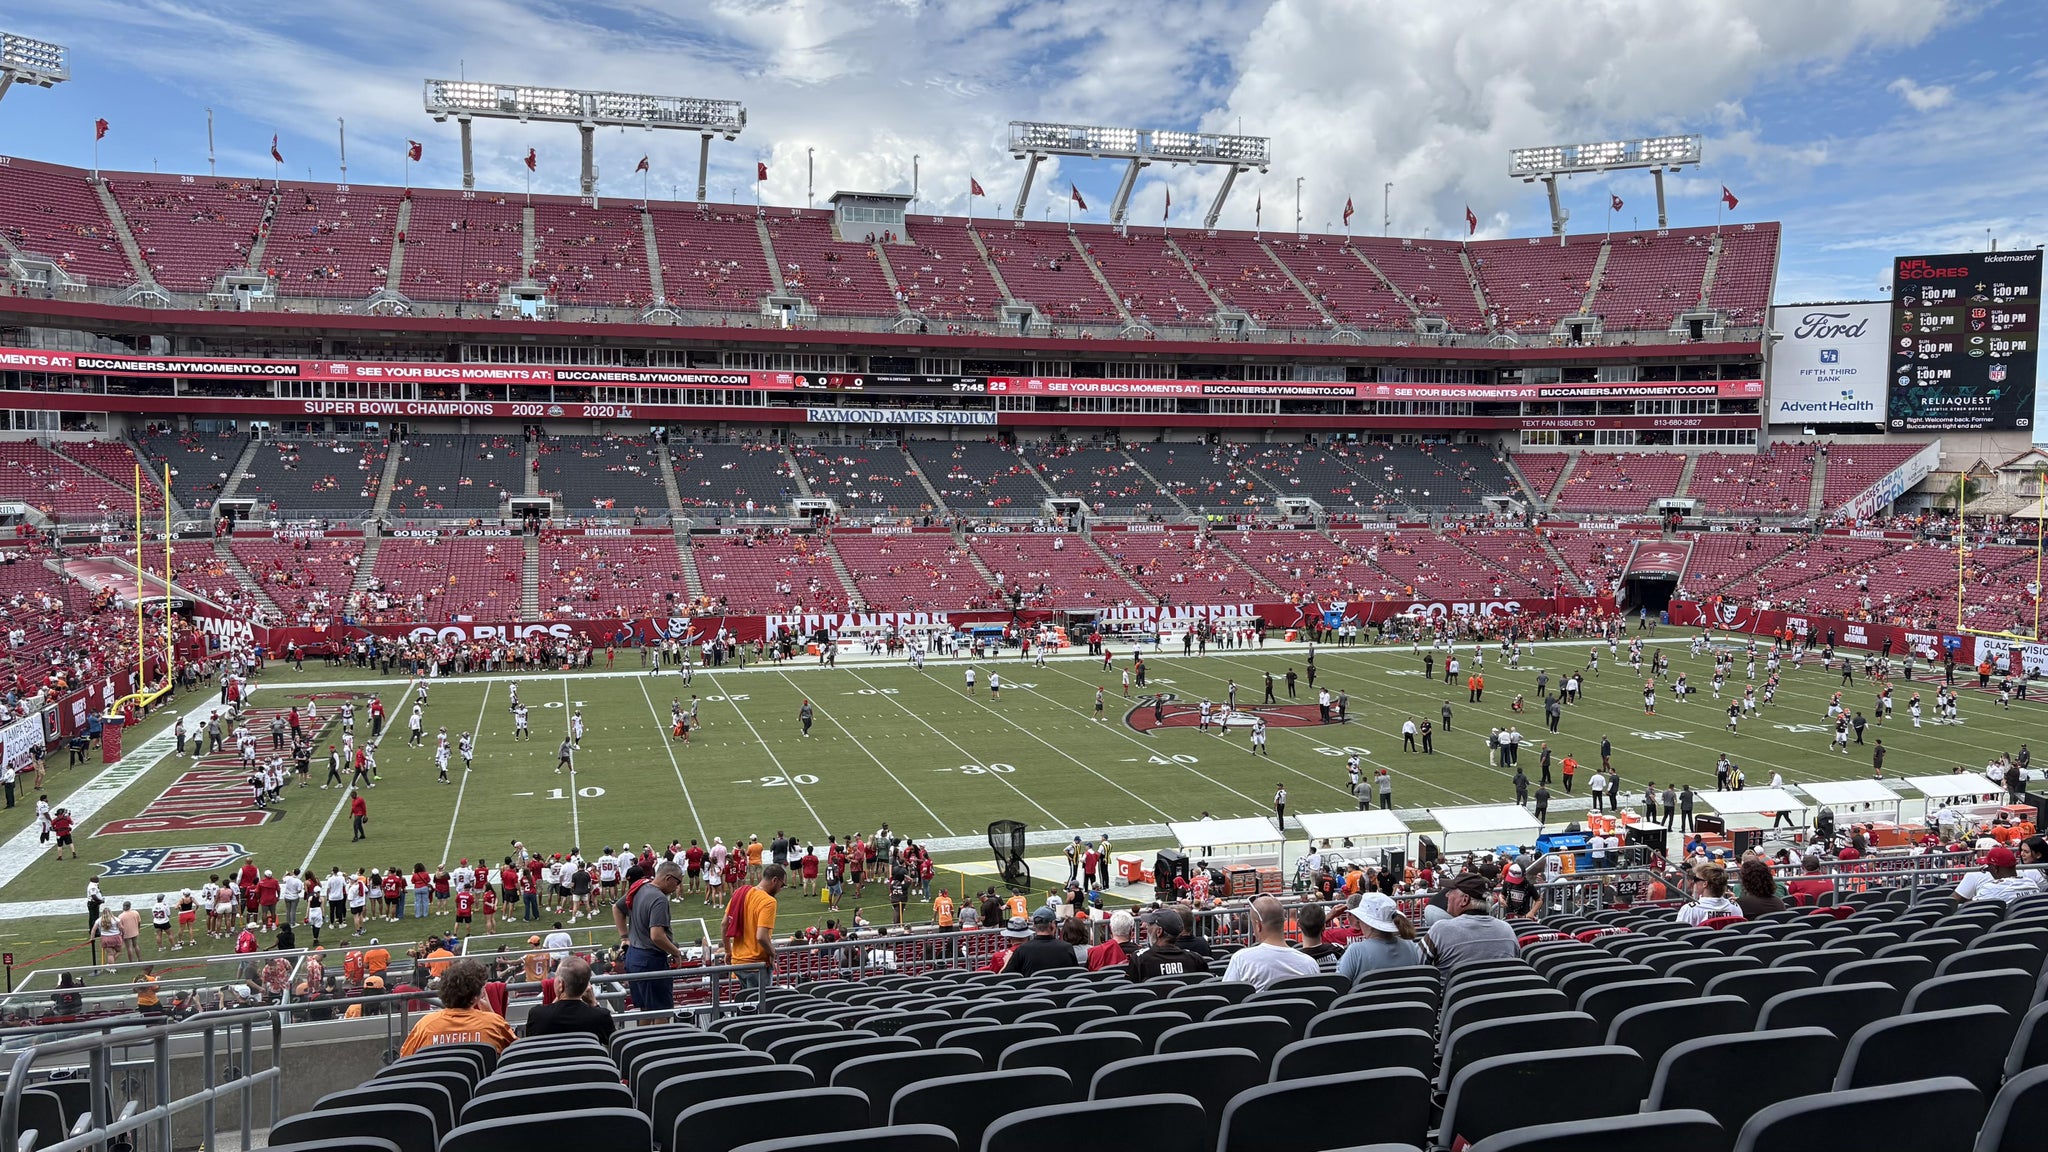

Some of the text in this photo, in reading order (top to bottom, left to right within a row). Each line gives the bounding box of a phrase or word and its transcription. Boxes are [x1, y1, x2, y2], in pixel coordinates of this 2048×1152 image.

[1984, 254, 2036, 263] ticketmaster
[1900, 260, 1931, 270] NFL
[1900, 268, 1968, 279] SCORES
[1921, 289, 1956, 299] 1:00 PM
[1993, 286, 2028, 296] 1:00 PM
[1920, 316, 1954, 325] 1:00 PM
[1991, 314, 2026, 323] 1:00 PM
[1794, 313, 1869, 339] Ford
[1918, 343, 1952, 353] 1:00 PM
[1990, 341, 2026, 351] 1:00 PM
[51, 357, 72, 366] AT:
[78, 359, 297, 375] BUCCANEERS.MYMOMENTO.COM
[356, 367, 748, 383] SEE YOUR BUCS MOMENTS AT: BUCCANEERS.MYMOMENTO.COM
[1917, 370, 1951, 379] 1:00 PM
[818, 377, 827, 385] 0
[855, 378, 863, 386] 0
[990, 382, 1006, 390] 25
[952, 384, 984, 392] 37:45
[1048, 383, 1068, 392] SEE
[1070, 384, 1099, 392] YOUR
[1101, 384, 1128, 392] BUCS
[1130, 384, 1182, 393] MOMENTS
[1204, 386, 1354, 395] BUCCANEERS.MYMOMENTO.COM
[1468, 389, 1517, 397] MOMENTS
[1541, 387, 1715, 396] BUCCANEERS.MYMOMENTO.COM
[1780, 401, 1873, 411] AdventHealth
[1922, 397, 1991, 406] RELIAQUEST
[305, 402, 614, 417] SUPER BOWL CHAMPIONS 2002 2020
[810, 410, 996, 424] RAYMOND JAMES STADIUM
[1408, 603, 1447, 617] GO
[192, 616, 254, 641] TAMPA
[408, 624, 572, 642] GO BUCS
[1848, 625, 1864, 635] TEAM
[1844, 633, 1867, 645] GODWIN
[1312, 747, 1371, 757] 50
[1148, 754, 1199, 765] 40
[960, 764, 1016, 775] 30
[760, 774, 819, 787] 20
[546, 787, 605, 799] 10
[602, 863, 613, 871] 50
[1120, 864, 1128, 875] G
[1550, 862, 1558, 872] 12
[1620, 882, 1637, 891] 234
[460, 899, 467, 910] 6
[940, 904, 950, 915] 13
[1017, 902, 1023, 912] 6
[1708, 911, 1732, 919] GARRETT
[535, 962, 543, 975] 6
[1160, 962, 1183, 974] FORD
[432, 1032, 480, 1044] MAYFIELD
